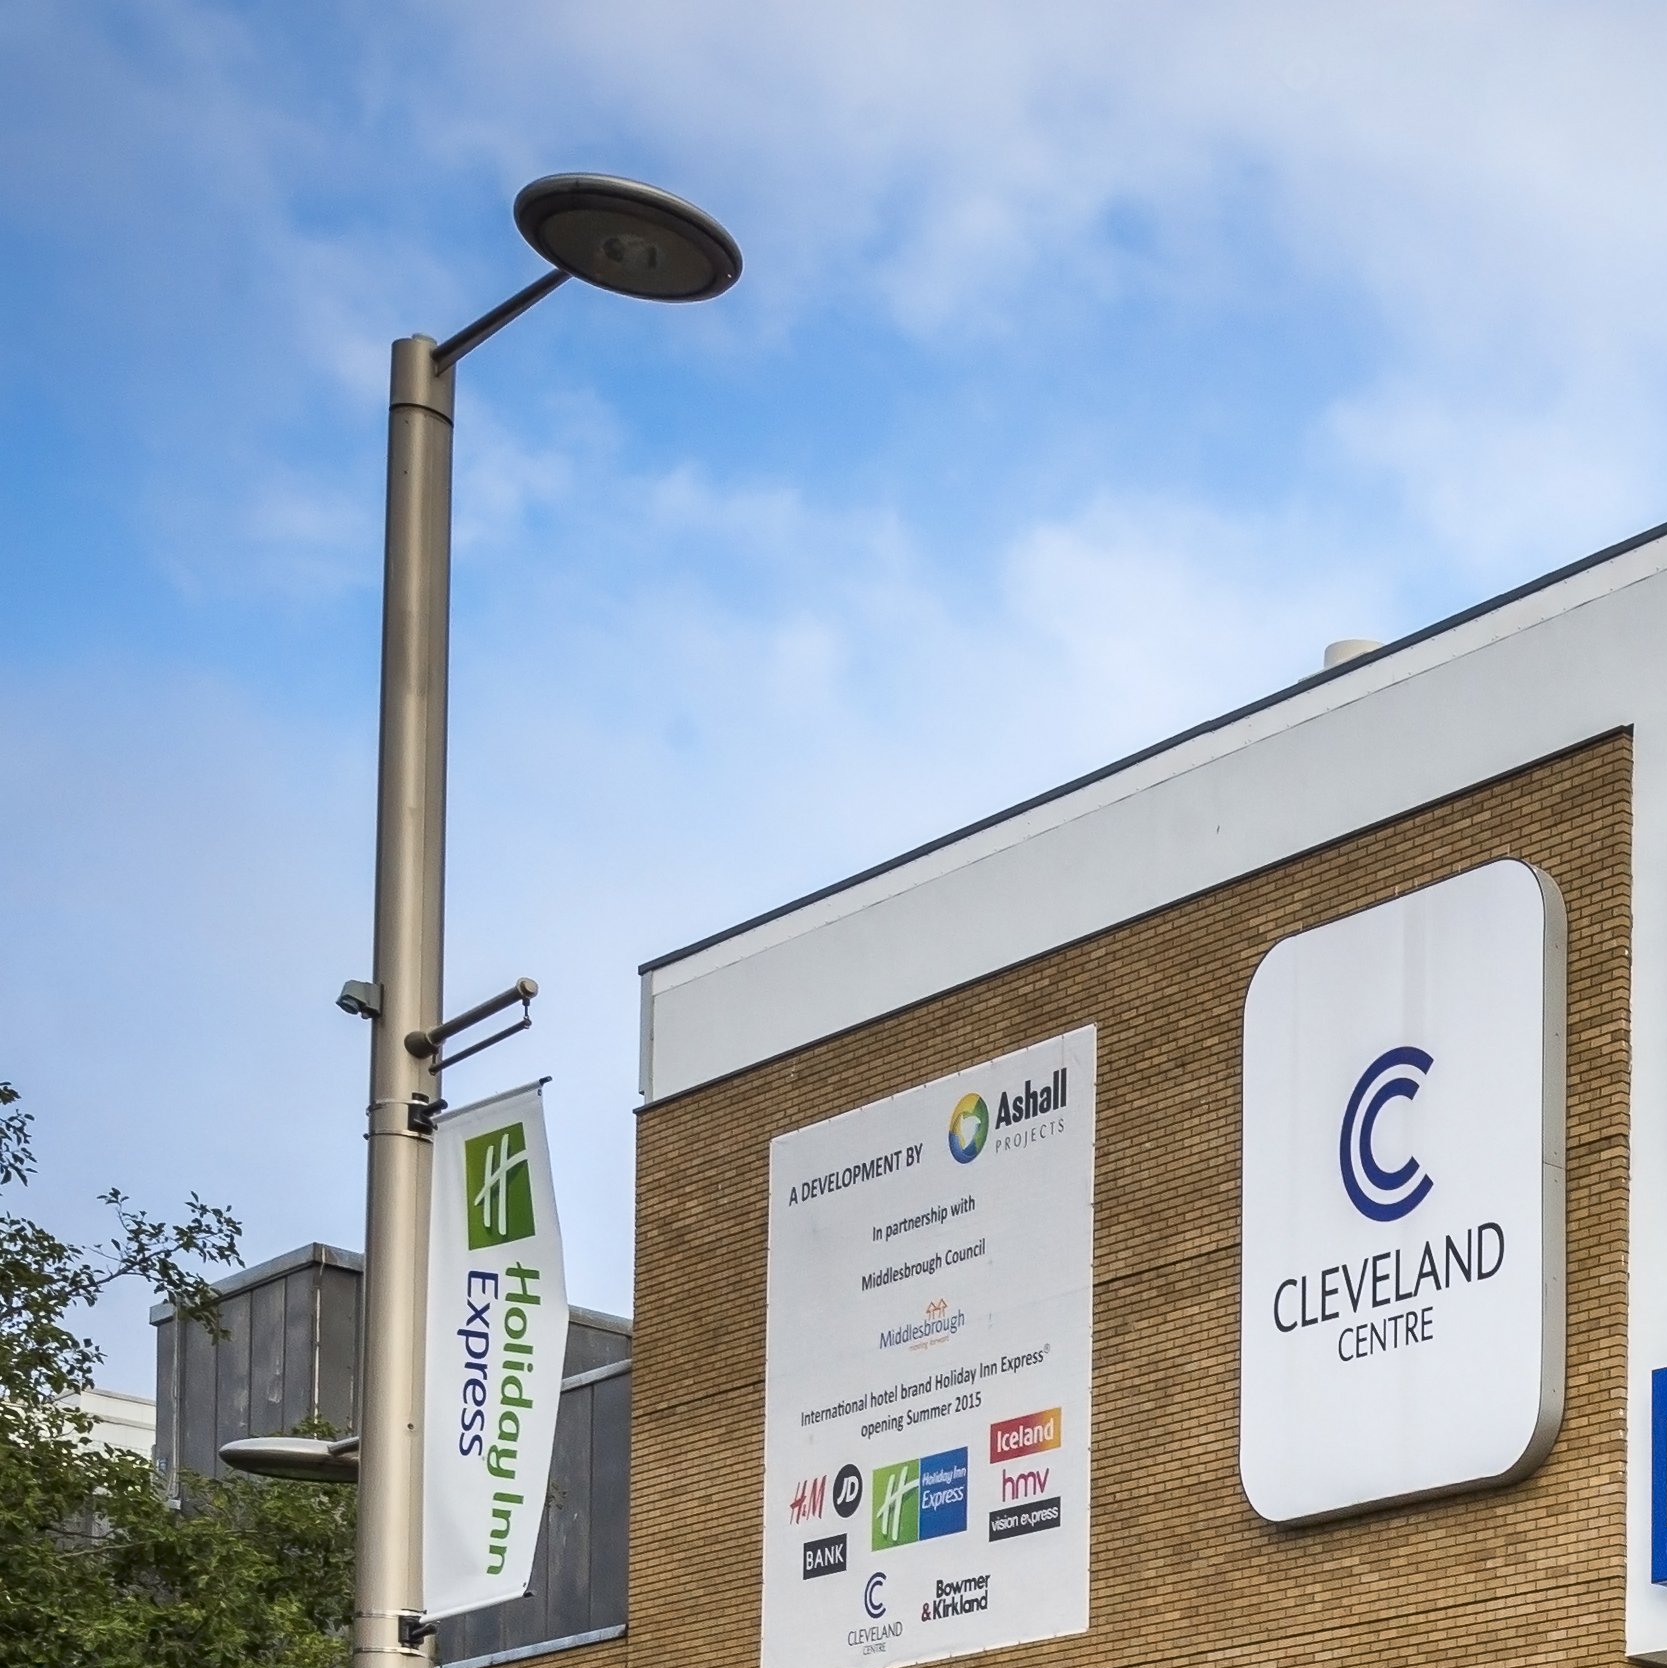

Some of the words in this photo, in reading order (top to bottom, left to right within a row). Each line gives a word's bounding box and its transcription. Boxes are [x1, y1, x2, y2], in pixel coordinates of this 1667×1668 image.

[995, 1067, 1067, 1130] Ashall
[995, 1118, 1065, 1153] PROJECTS
[789, 1186, 799, 1207] A
[801, 1151, 902, 1203] DEVELOPMENT
[905, 1143, 924, 1167] BY
[872, 1226, 883, 1242] In
[885, 1203, 948, 1237] partnership
[950, 1195, 975, 1217] with
[861, 1254, 942, 1291] Middlesbrough
[945, 1238, 986, 1265] Council
[1273, 1221, 1506, 1333] CLEVELAND
[879, 1309, 965, 1349] Middlesbrough
[1337, 1306, 1434, 1363] CENTRE
[457, 1269, 499, 1457] Express
[486, 1261, 541, 1480] Holiday
[800, 1393, 868, 1427] International
[870, 1384, 898, 1410] hotel
[900, 1375, 932, 1401] brand
[935, 1366, 977, 1393] Holiday
[979, 1360, 998, 1378] Inn
[860, 1416, 904, 1438] opening
[906, 1404, 953, 1426] Summer
[954, 1391, 982, 1413] 2015
[997, 1419, 1054, 1452] Iceland
[837, 1475, 859, 1505] JD
[922, 1468, 952, 1487] Holiday
[953, 1465, 966, 1479] Inn
[1002, 1467, 1050, 1502] hmv
[790, 1474, 827, 1525] H&M
[922, 1485, 964, 1511] Express
[991, 1512, 1019, 1532] vision
[1020, 1505, 1059, 1527] express
[486, 1490, 524, 1575] Inn
[806, 1544, 844, 1571] BANK
[936, 1574, 991, 1599] Bowmer
[848, 1621, 903, 1647] CLEVELAND
[863, 1642, 886, 1655] CENTRE
